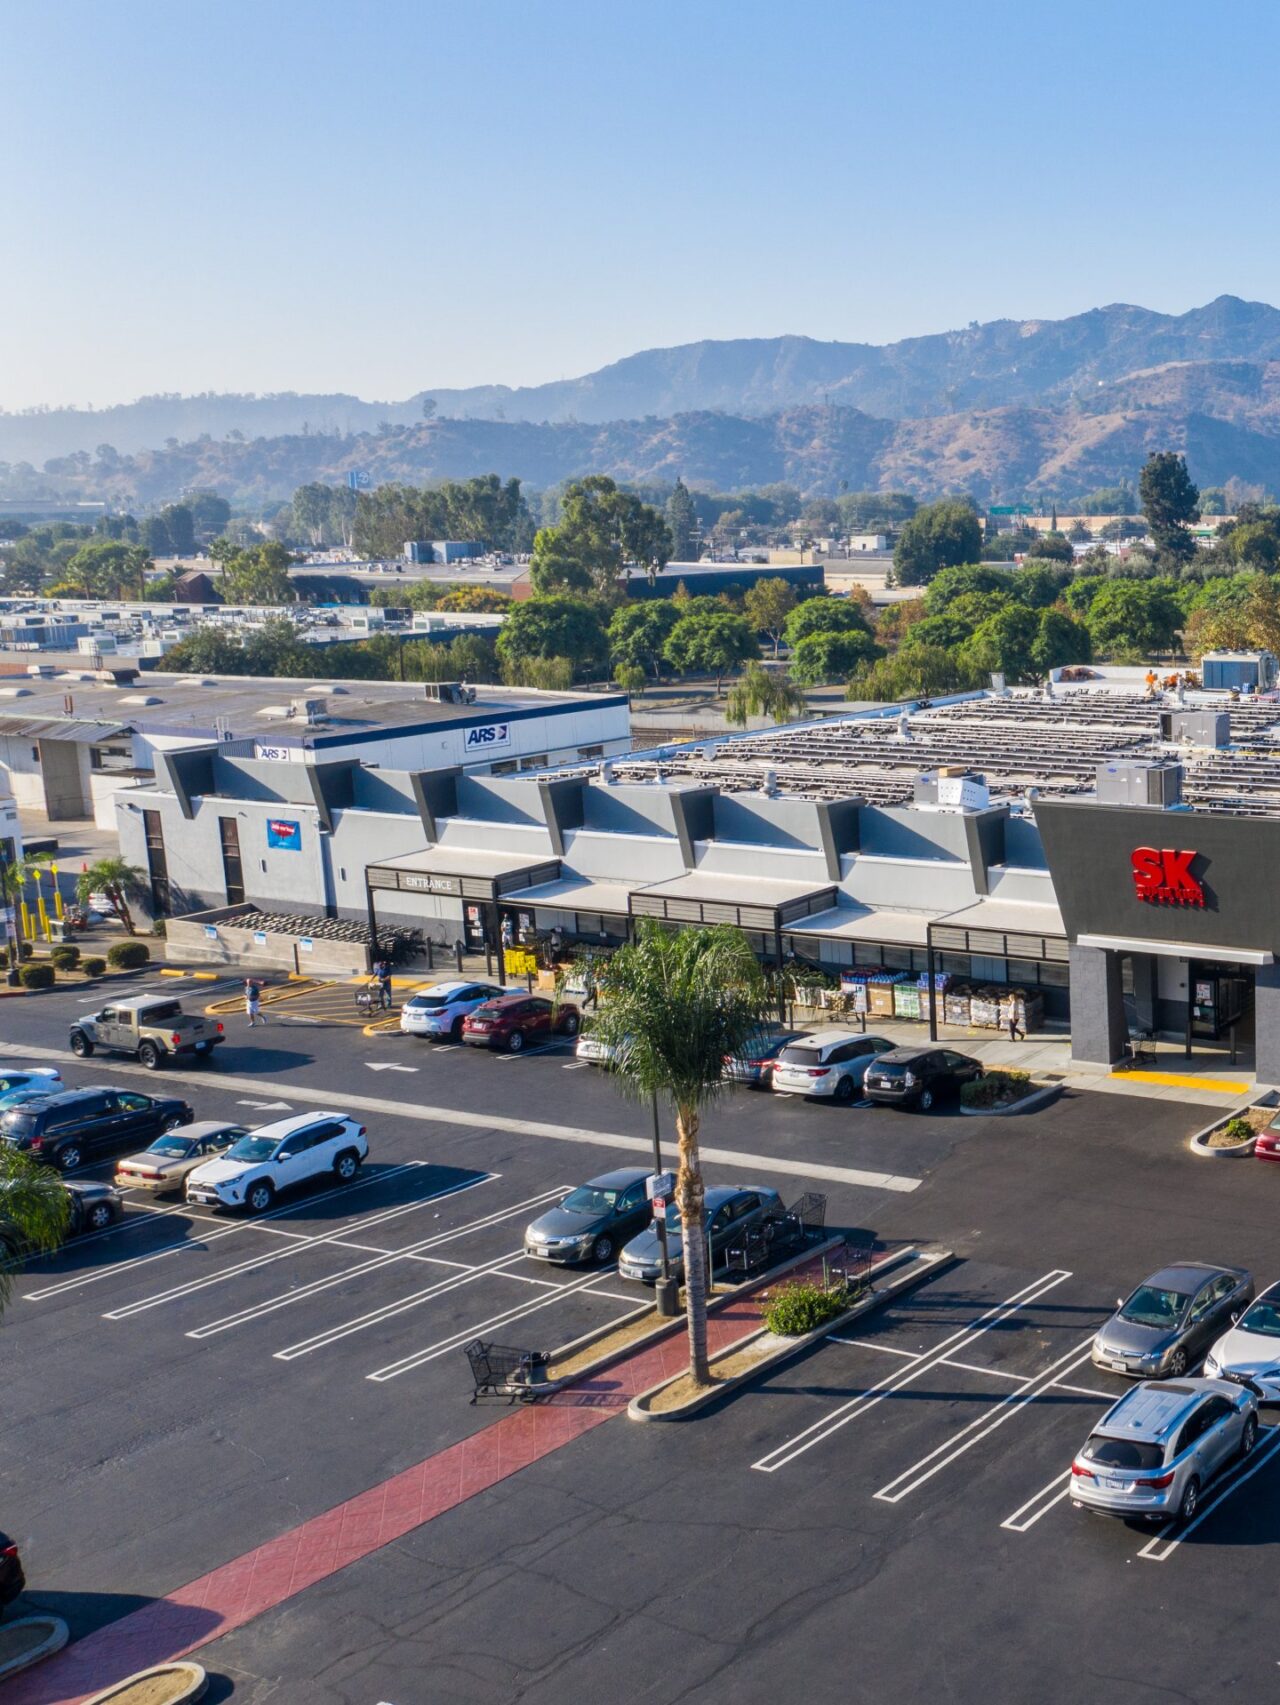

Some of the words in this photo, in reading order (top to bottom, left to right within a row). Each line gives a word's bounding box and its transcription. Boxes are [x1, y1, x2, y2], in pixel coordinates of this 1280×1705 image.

[468, 727, 496, 745] ARS
[261, 749, 279, 759] ARS
[1131, 847, 1200, 889] SK
[406, 876, 452, 890] ENTRANCE
